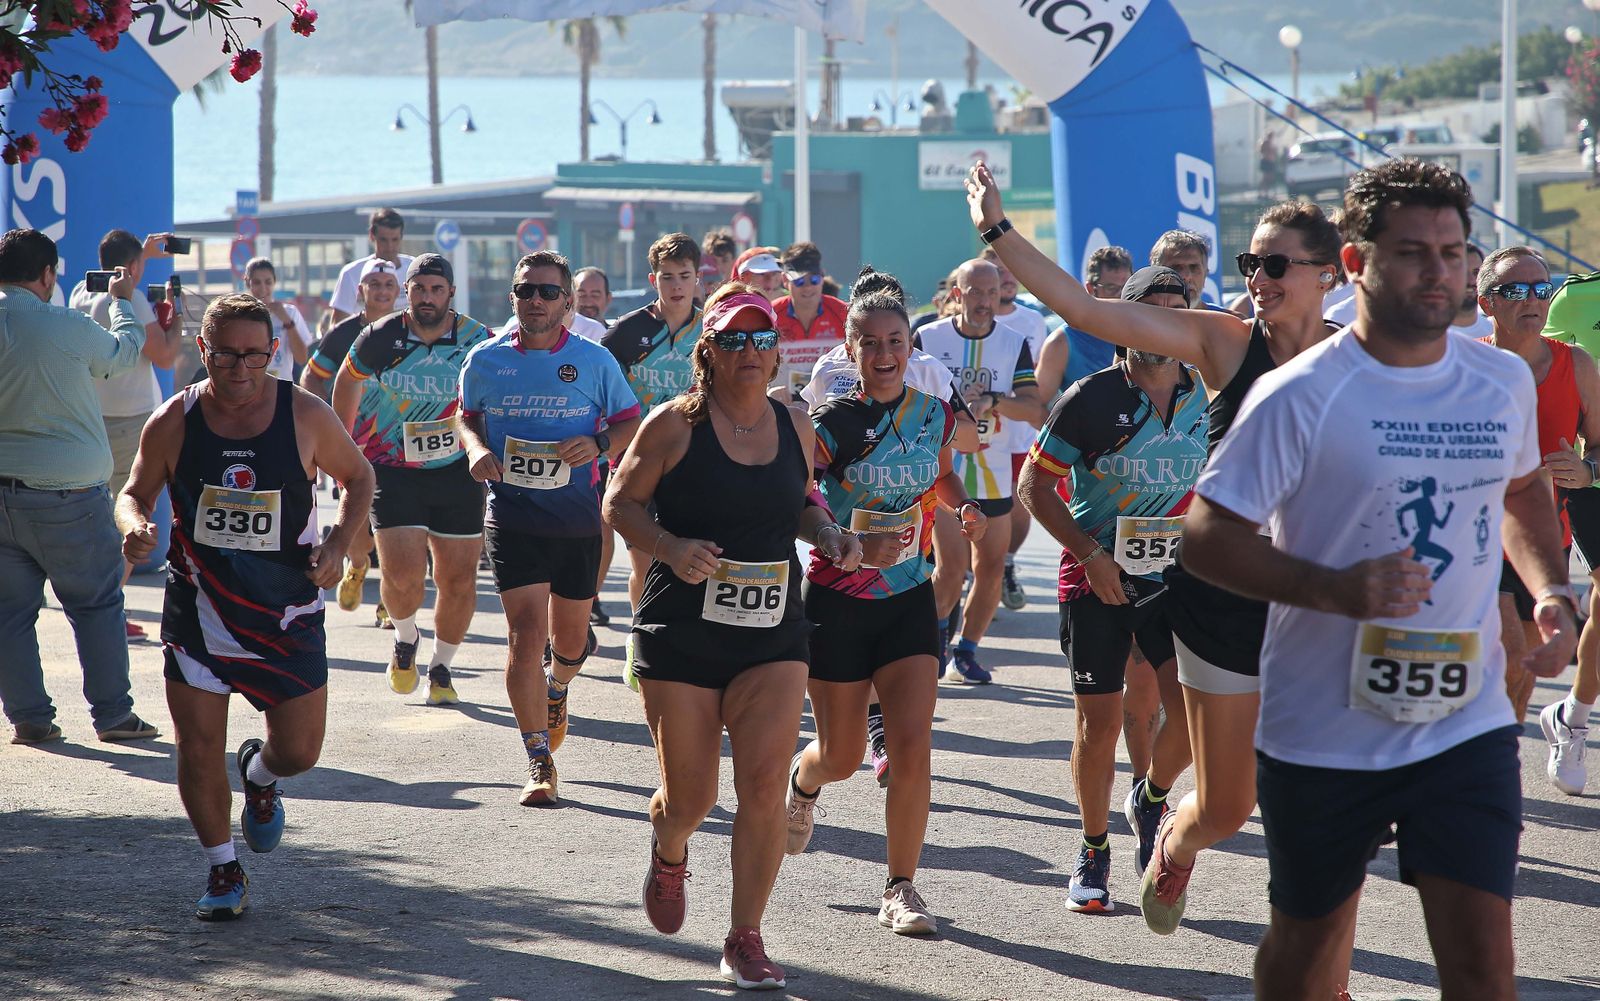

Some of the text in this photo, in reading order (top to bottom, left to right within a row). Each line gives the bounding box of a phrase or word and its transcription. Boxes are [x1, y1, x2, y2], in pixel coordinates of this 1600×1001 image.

[380, 369, 459, 396] CORRU
[629, 364, 692, 389] CORRU
[1371, 420, 1508, 433] XXIII EDICIÓN
[411, 431, 455, 452] 185
[1385, 432, 1499, 446] CARRERA URBANA
[1378, 446, 1504, 460] CIUDAD DE ALGECIRAS
[510, 455, 562, 478] 207
[873, 488, 901, 497] TRAIL
[1126, 483, 1194, 494] TRAIL TEAM
[205, 508, 272, 535] 330
[715, 582, 782, 610] 206
[1368, 657, 1468, 698] 359
